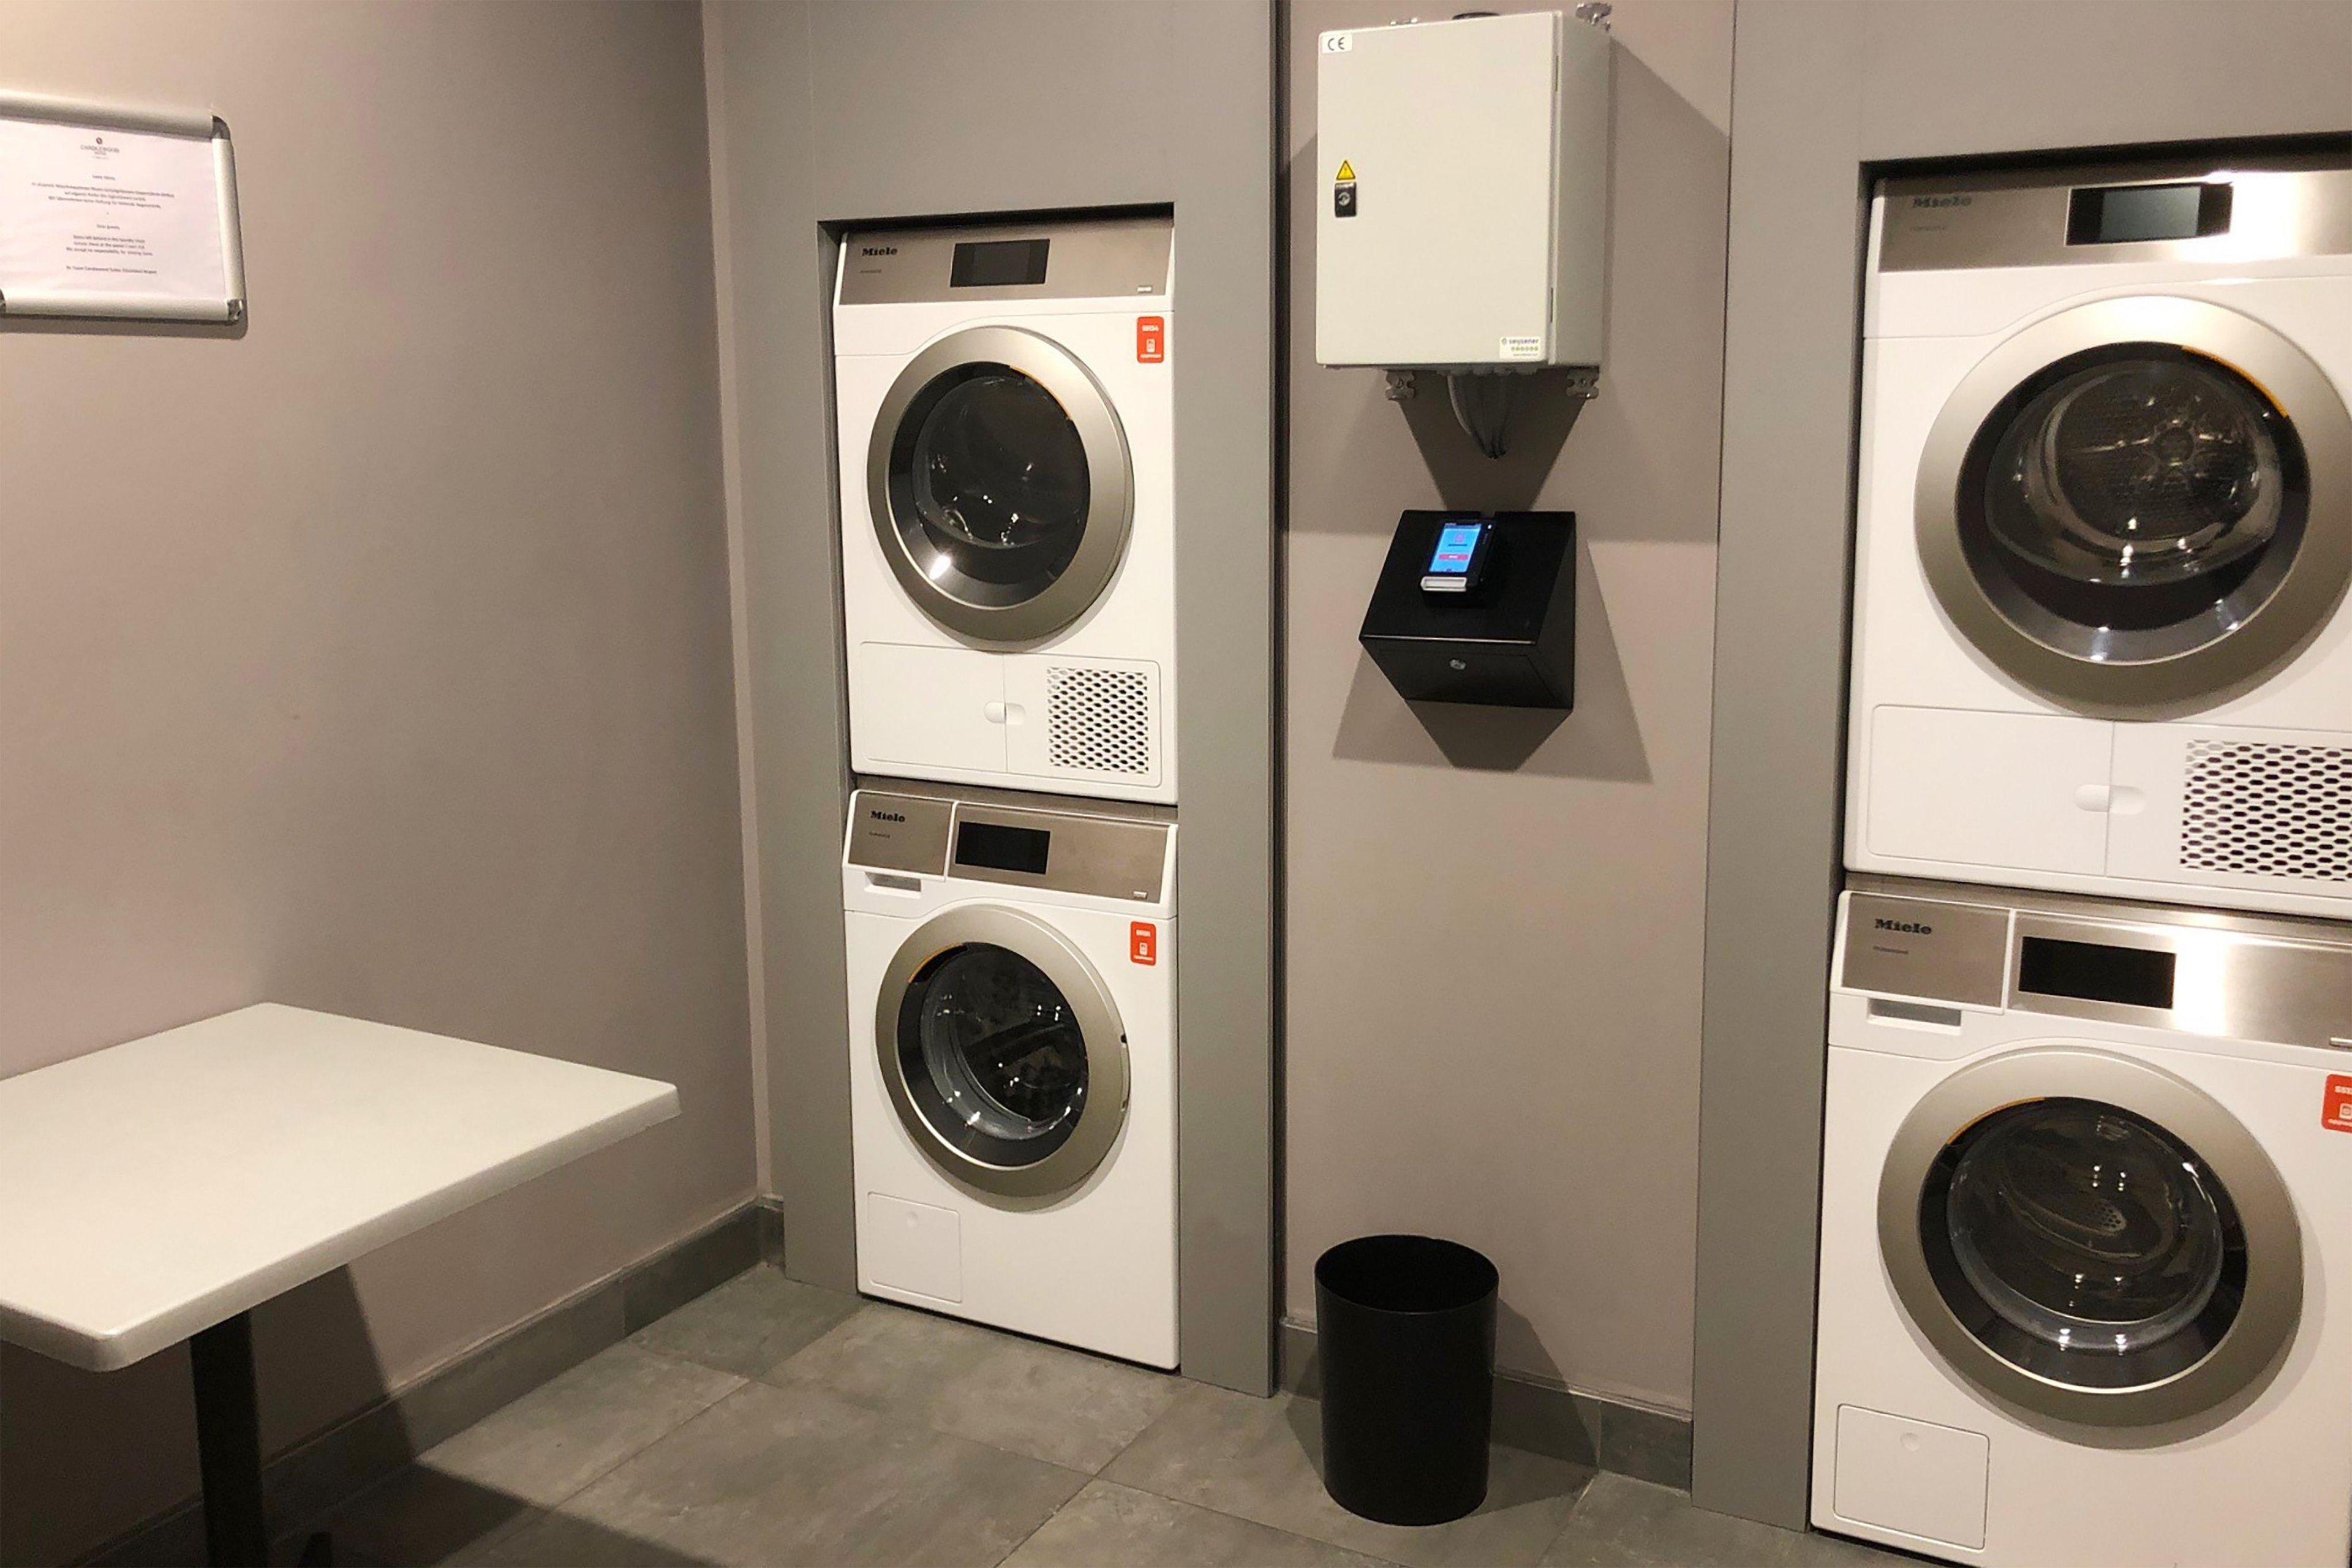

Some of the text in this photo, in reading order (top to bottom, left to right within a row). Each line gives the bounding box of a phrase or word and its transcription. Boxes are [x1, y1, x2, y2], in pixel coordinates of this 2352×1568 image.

[1327, 37, 1345, 51] CE
[1912, 195, 1972, 208] Miele
[862, 247, 898, 256] Miele
[870, 810, 905, 822] Miele
[1874, 918, 1932, 935] Miele
